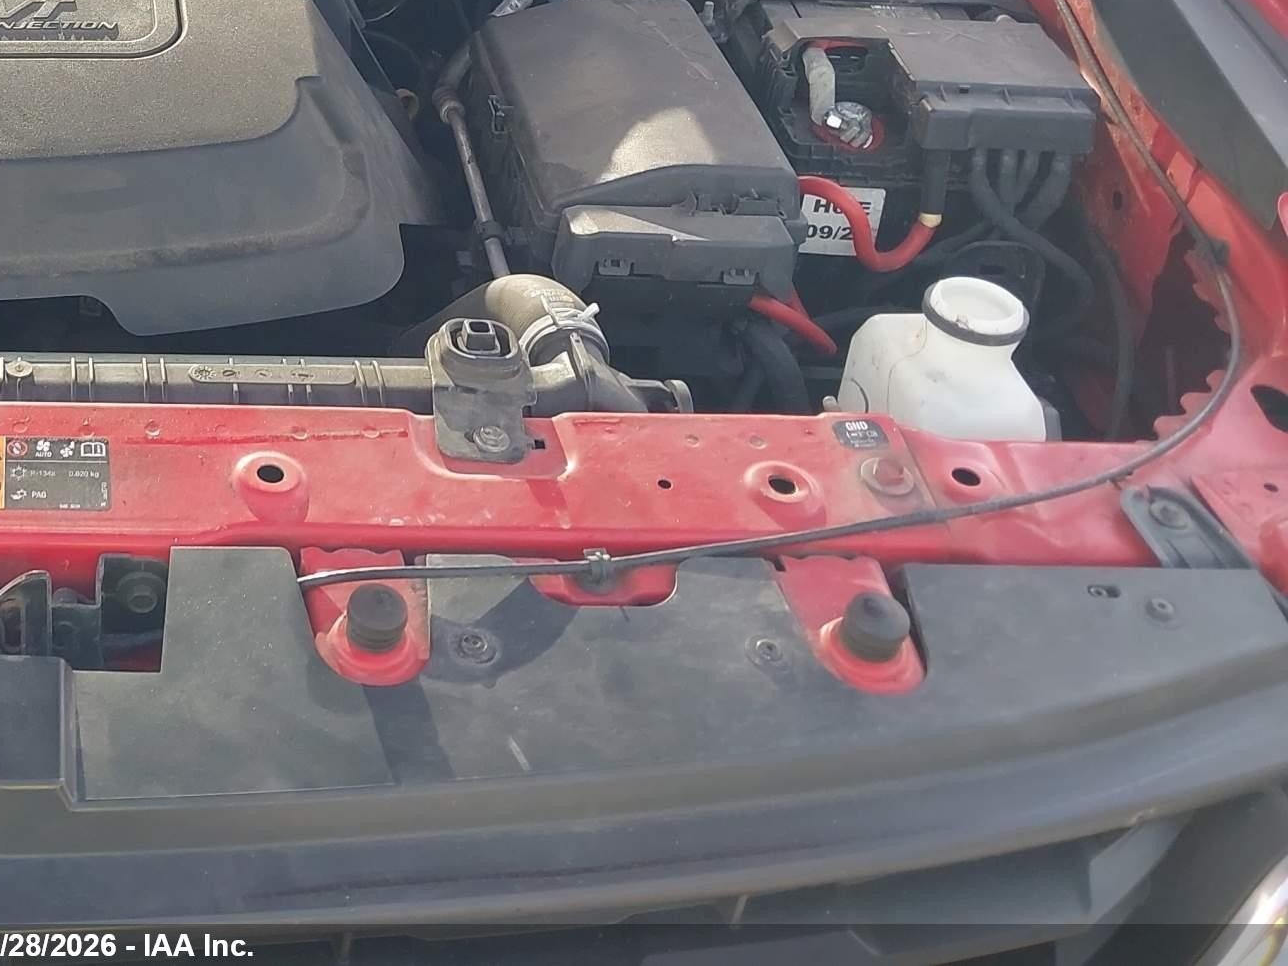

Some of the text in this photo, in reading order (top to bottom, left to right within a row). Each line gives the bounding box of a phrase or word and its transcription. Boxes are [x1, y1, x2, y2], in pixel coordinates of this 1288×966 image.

[845, 421, 868, 431] GND
[90, 470, 100, 479] kg
[31, 490, 47, 499] PAG
